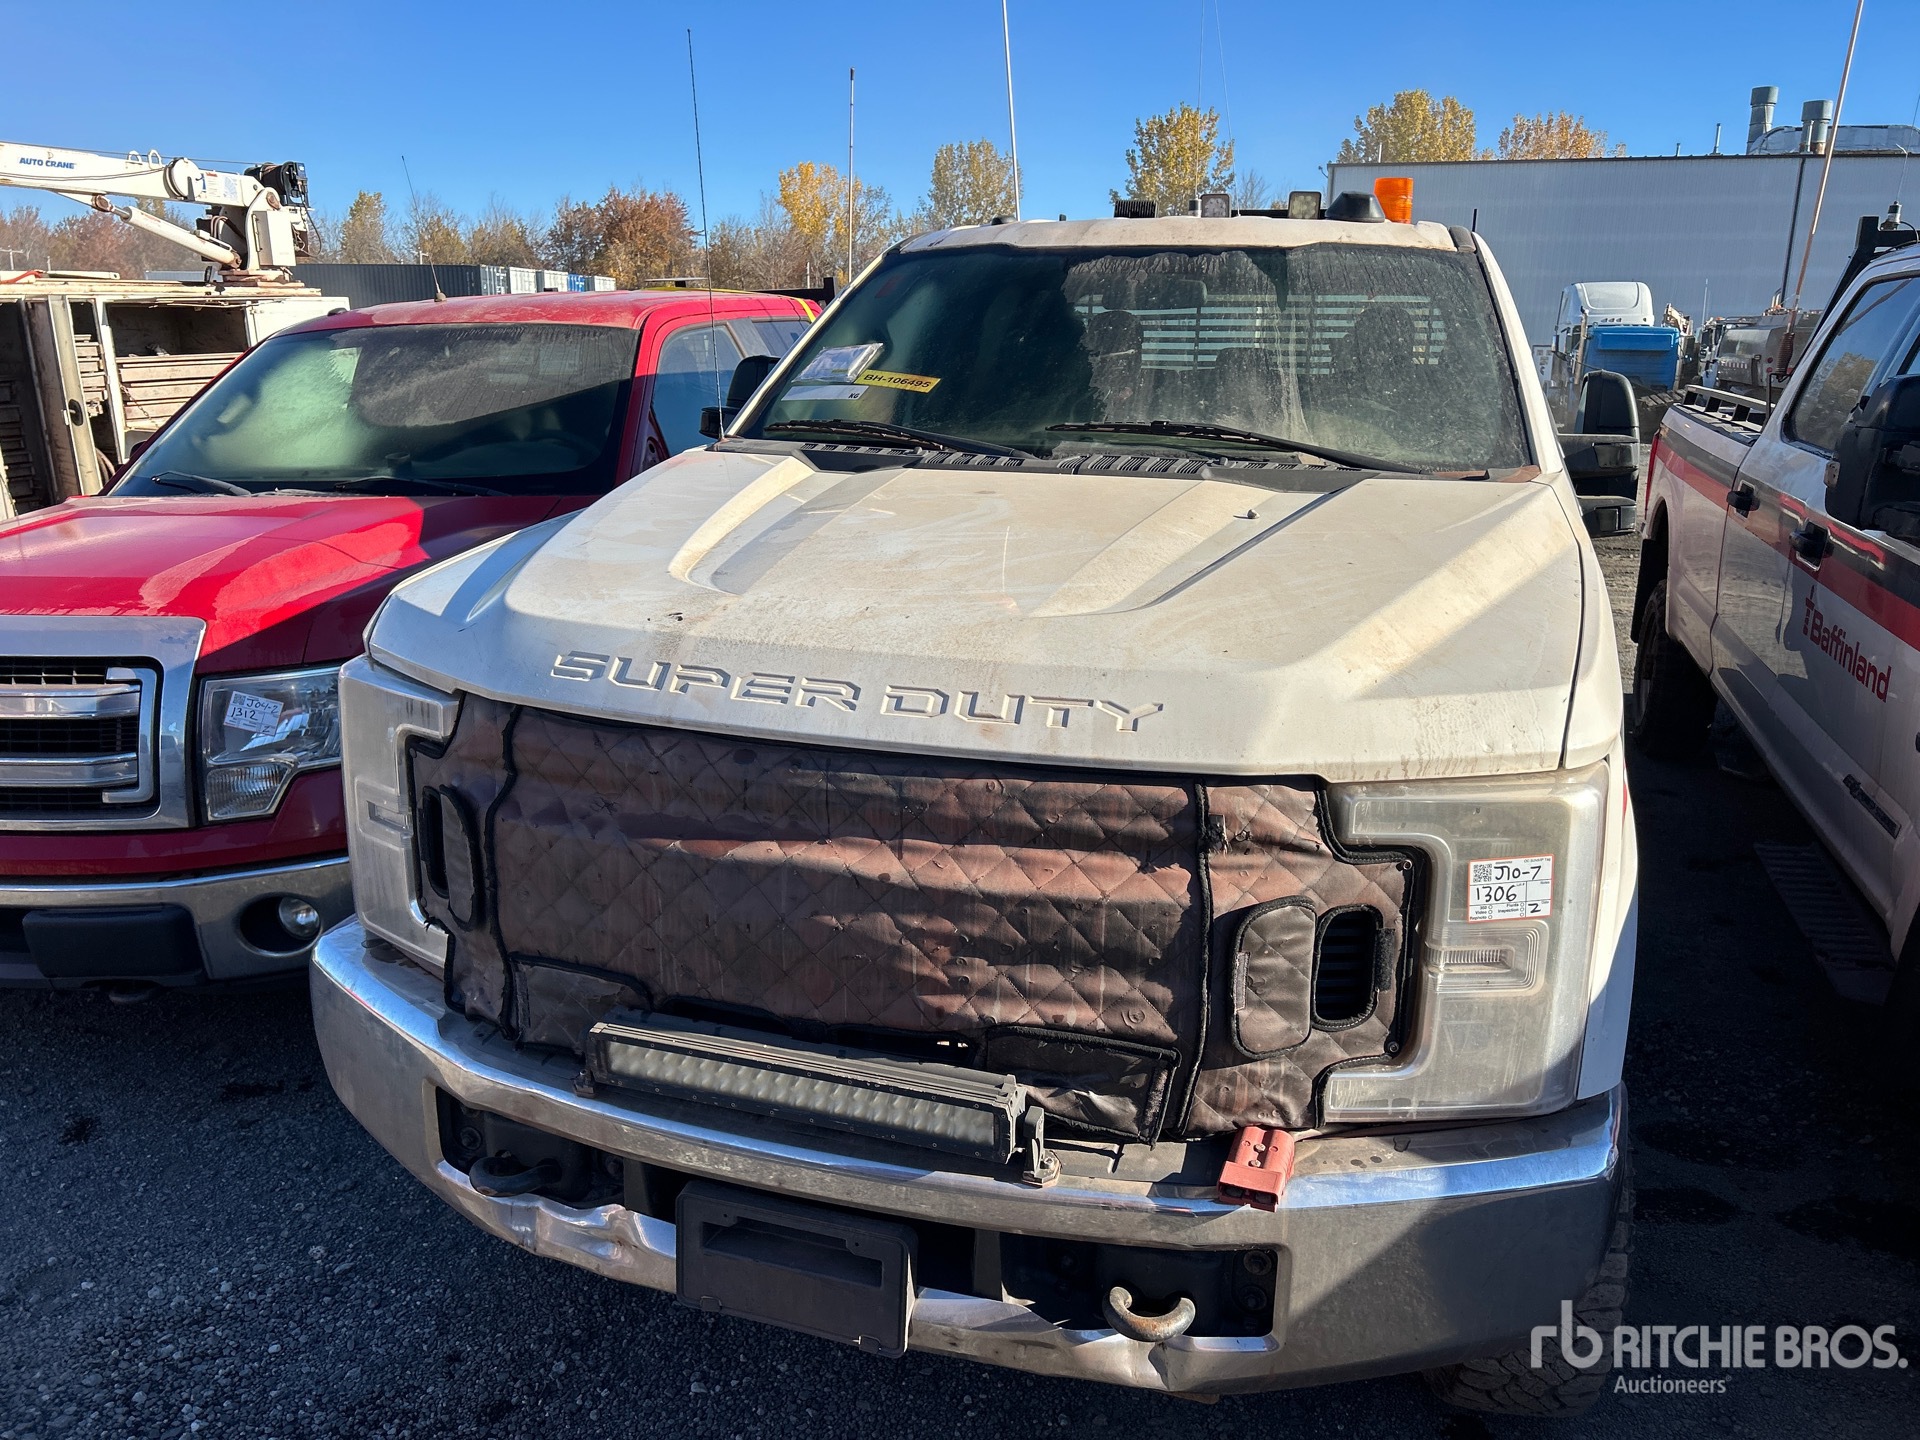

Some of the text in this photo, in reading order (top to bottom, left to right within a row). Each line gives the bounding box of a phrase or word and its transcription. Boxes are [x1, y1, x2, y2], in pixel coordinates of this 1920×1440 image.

[19, 157, 75, 170] AUTO CRANE
[863, 373, 932, 389] BH-106495
[1810, 609, 1892, 703] Baffinland
[549, 650, 1165, 734] SUPER DUTY
[230, 706, 259, 721] 1312
[1493, 865, 1542, 881] J10-7
[1476, 884, 1517, 903] 1306
